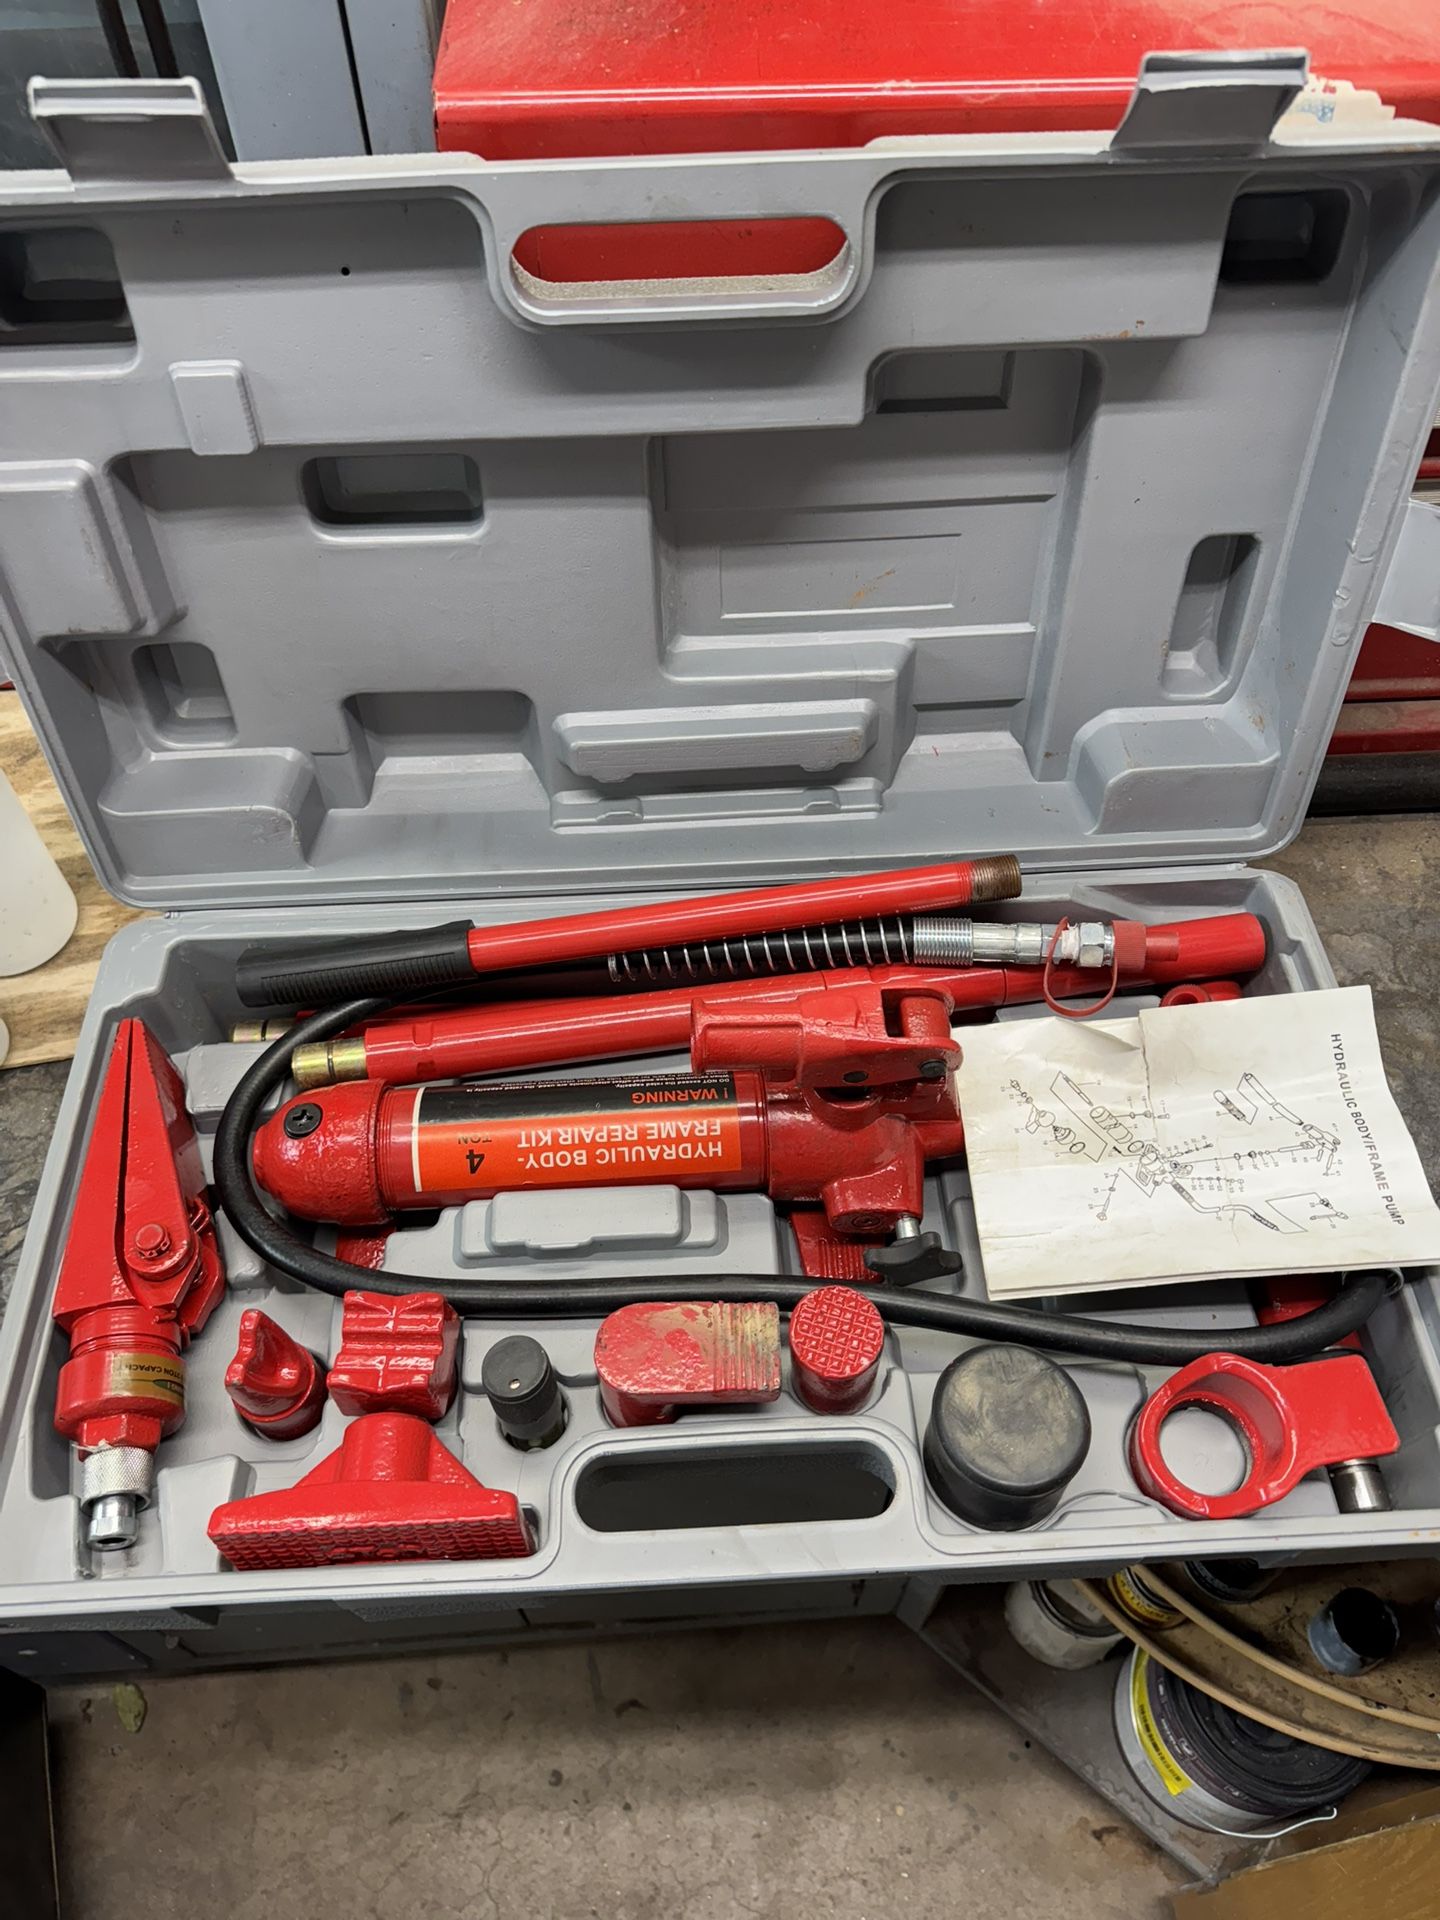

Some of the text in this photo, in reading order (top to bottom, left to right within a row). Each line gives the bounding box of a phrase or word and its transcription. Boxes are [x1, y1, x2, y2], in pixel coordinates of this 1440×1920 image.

[631, 1087, 719, 1105] WARNING
[457, 1133, 492, 1145] TON
[517, 1119, 721, 1148] FRAME REPAIR KIT
[1331, 1033, 1405, 1226] HYDRAULIC BODY/FRAME PUMP
[465, 1149, 485, 1175] 4
[517, 1141, 722, 1169] HYDRAULIC BODY-
